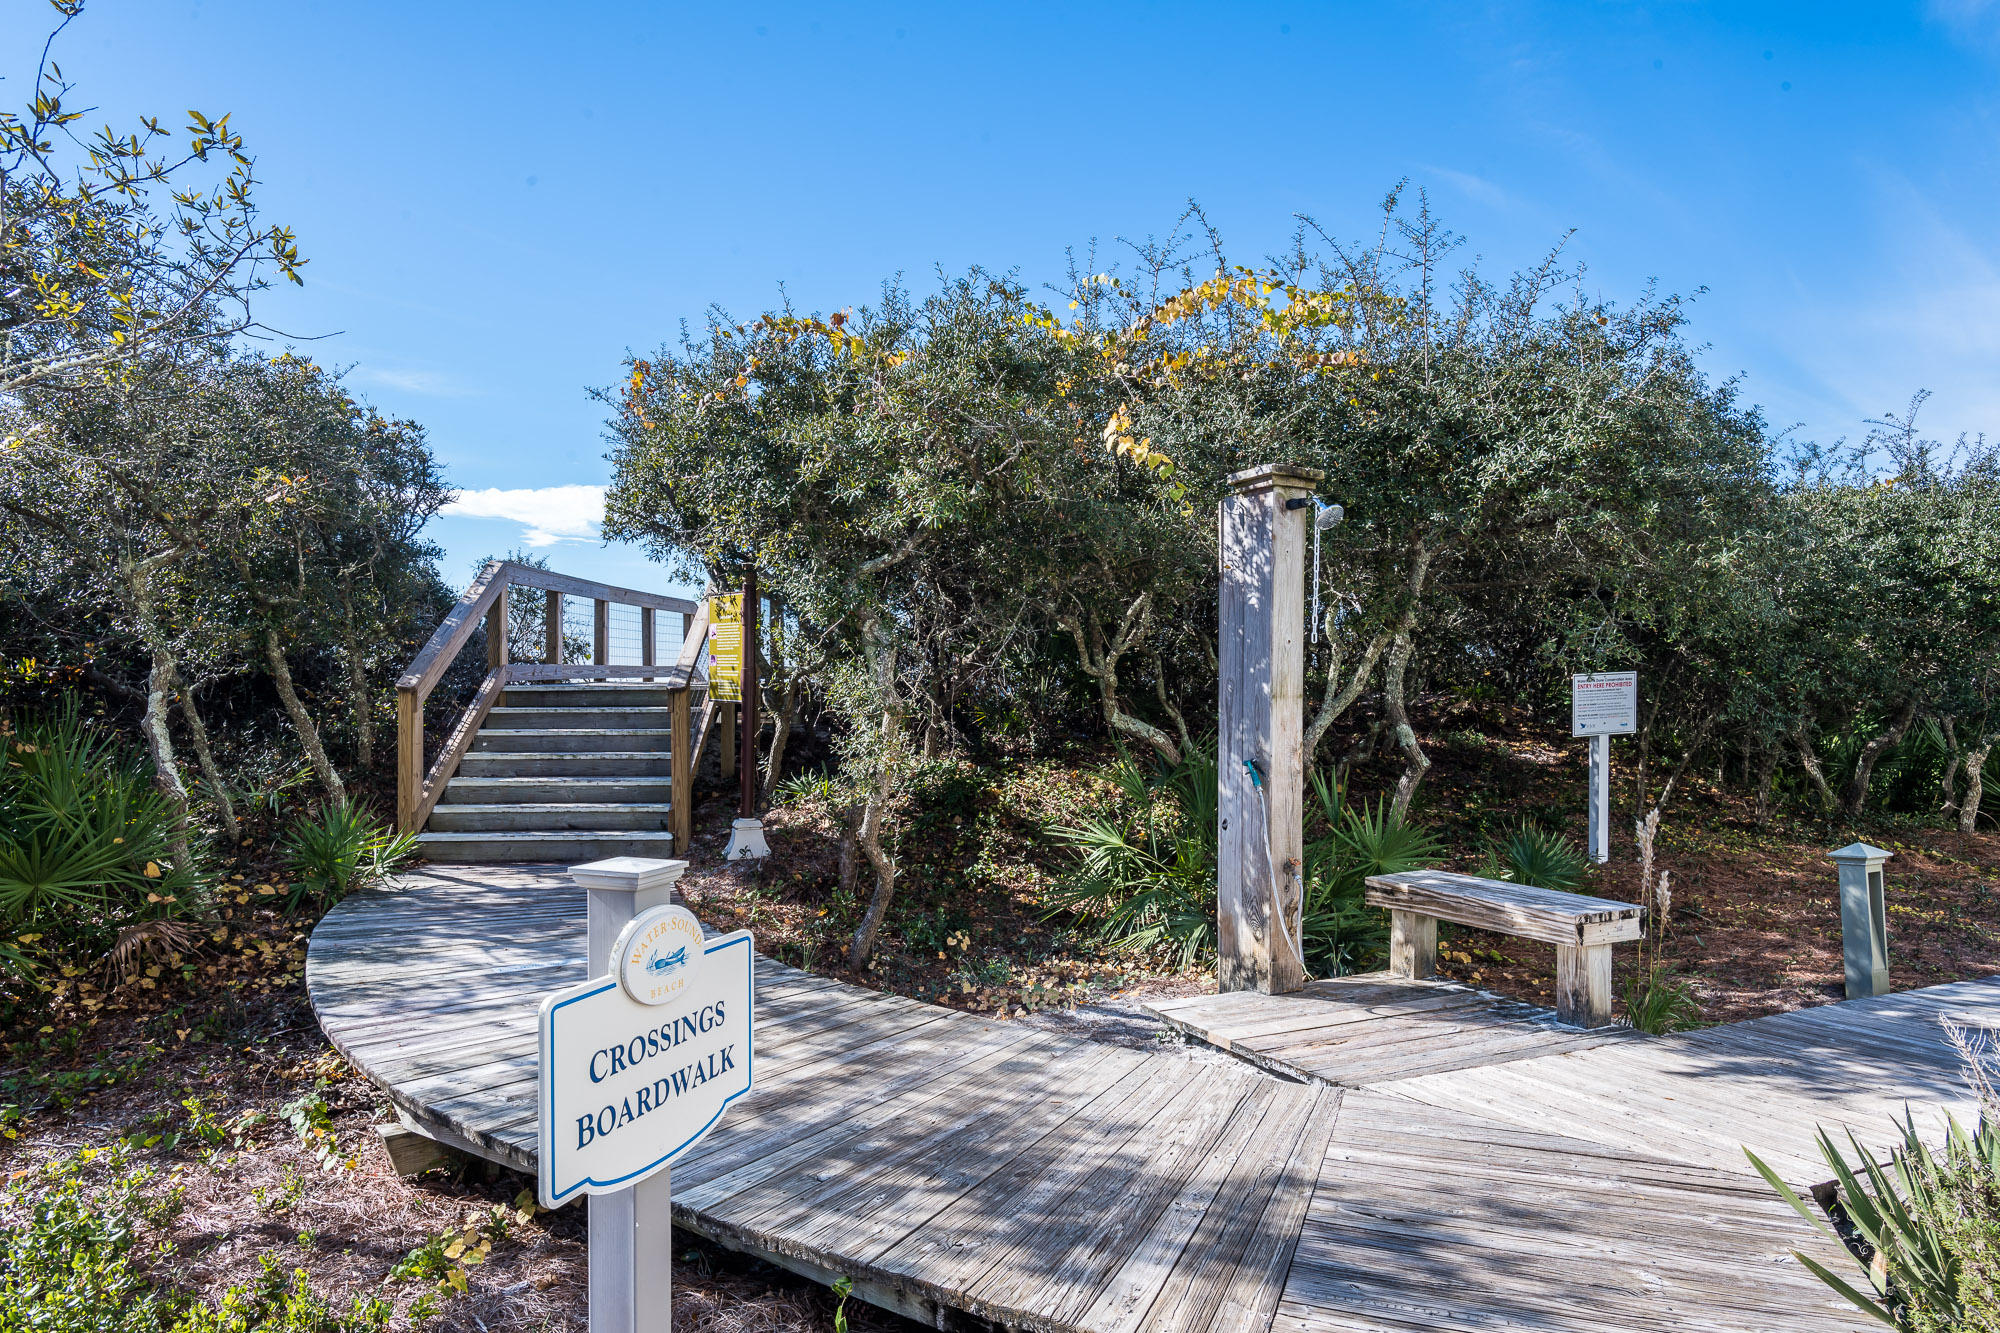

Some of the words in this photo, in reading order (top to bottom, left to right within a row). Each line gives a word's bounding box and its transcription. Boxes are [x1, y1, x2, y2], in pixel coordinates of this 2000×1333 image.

[650, 977, 684, 999] BEACH
[589, 1000, 726, 1084] CROSSINGS
[576, 1043, 736, 1151] BOARDWALK
